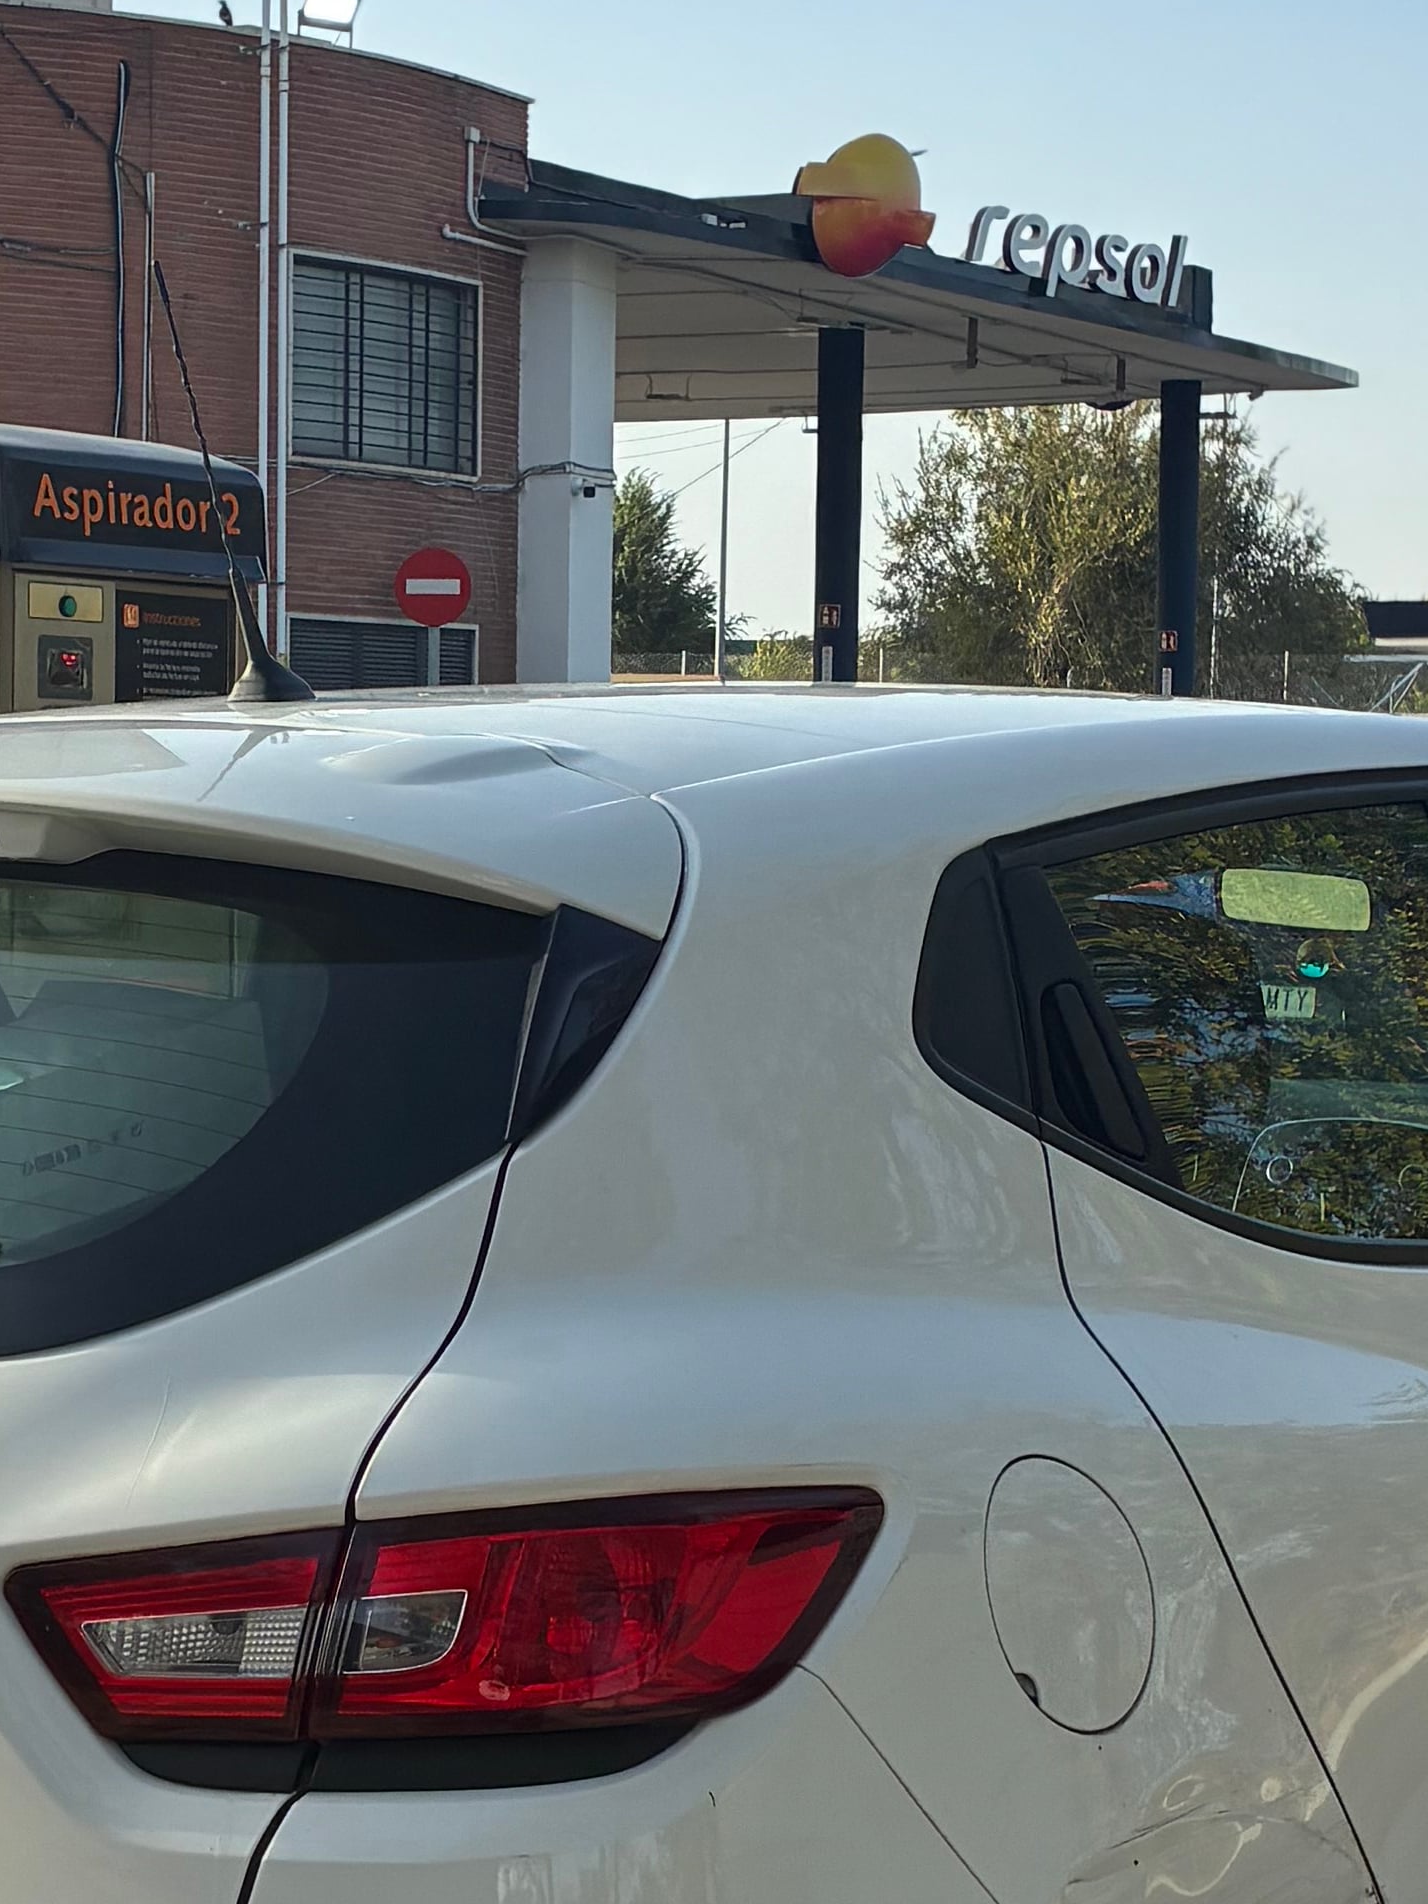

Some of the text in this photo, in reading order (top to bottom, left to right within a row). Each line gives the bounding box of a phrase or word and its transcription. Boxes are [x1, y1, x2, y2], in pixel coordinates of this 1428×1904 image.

[964, 205, 1188, 307] repsol
[33, 472, 241, 536] Aspirador 2
